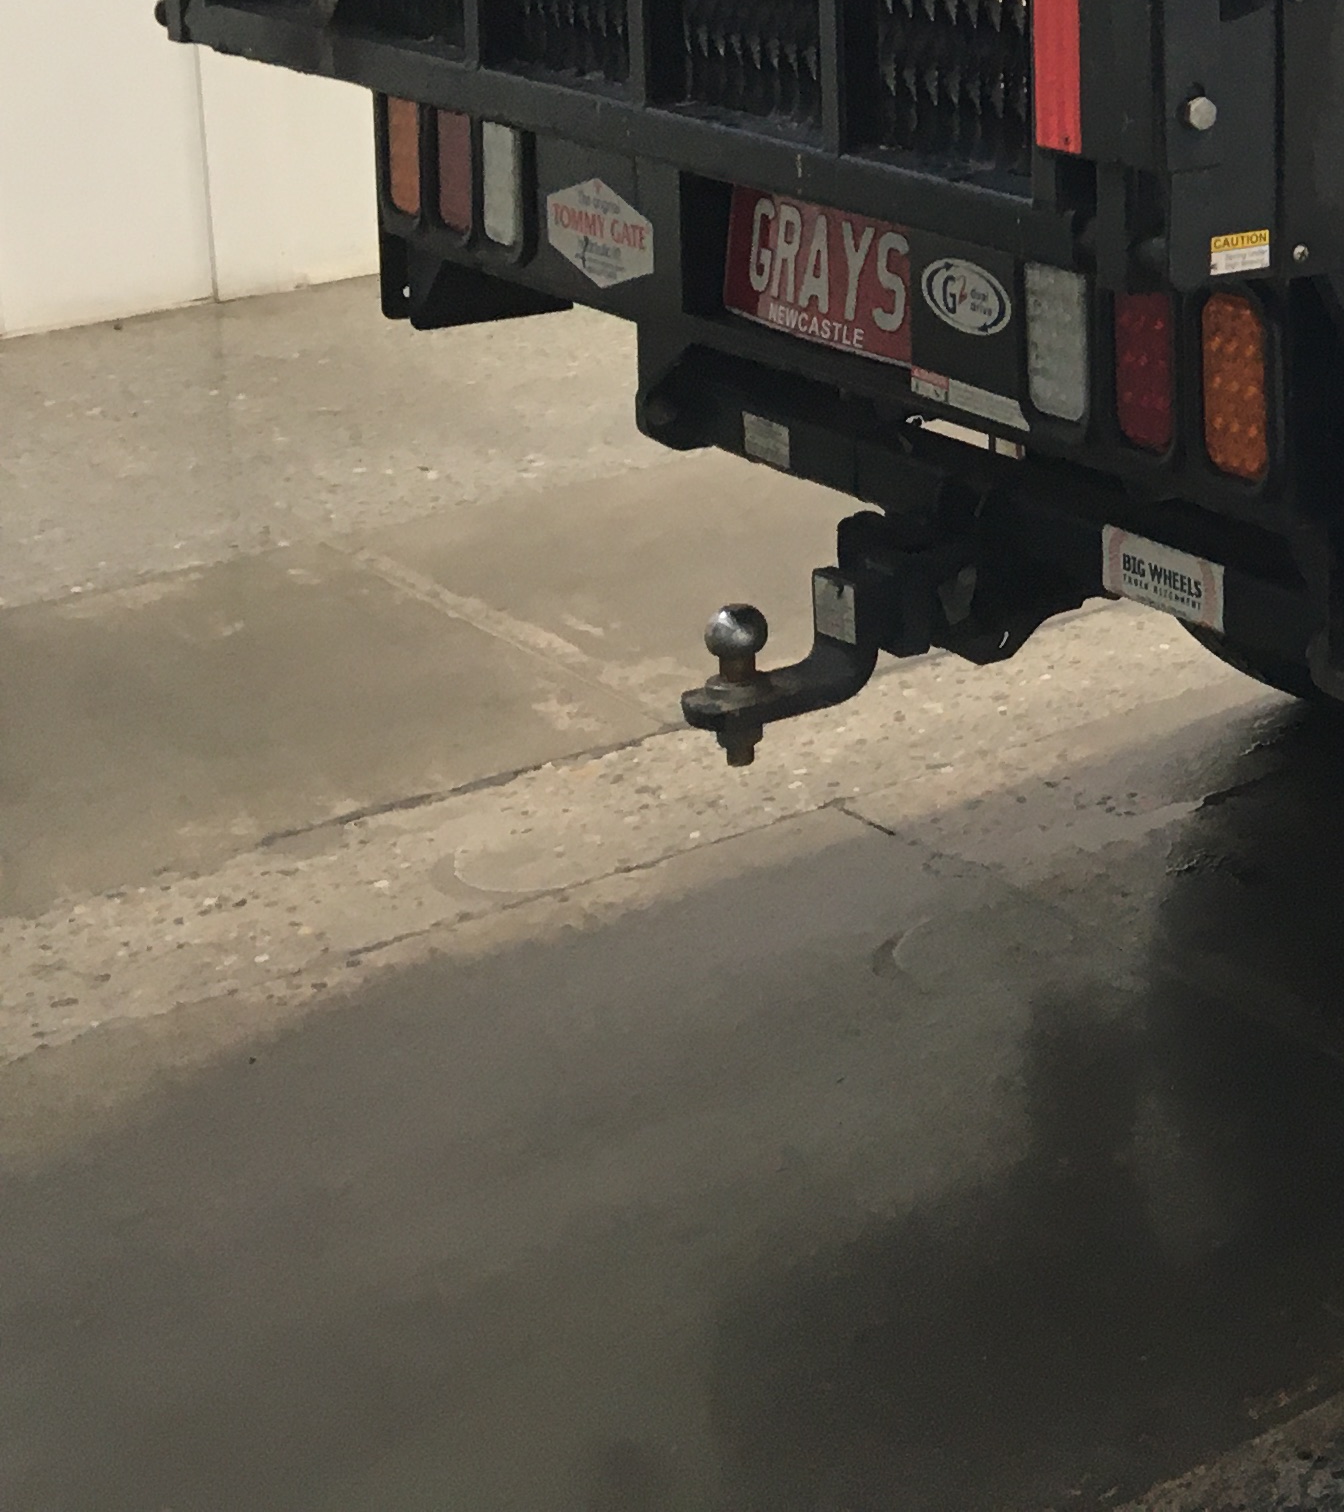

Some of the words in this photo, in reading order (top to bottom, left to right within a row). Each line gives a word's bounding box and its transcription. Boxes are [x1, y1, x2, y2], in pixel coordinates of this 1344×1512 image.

[552, 203, 606, 239] TOMMY
[610, 218, 646, 251] GATE
[1213, 232, 1267, 250] CAUTION
[749, 196, 910, 332] GRAYS
[767, 301, 865, 349] NEWCASTLE
[1122, 552, 1146, 578] BIG
[1148, 561, 1203, 599] WHEELS
